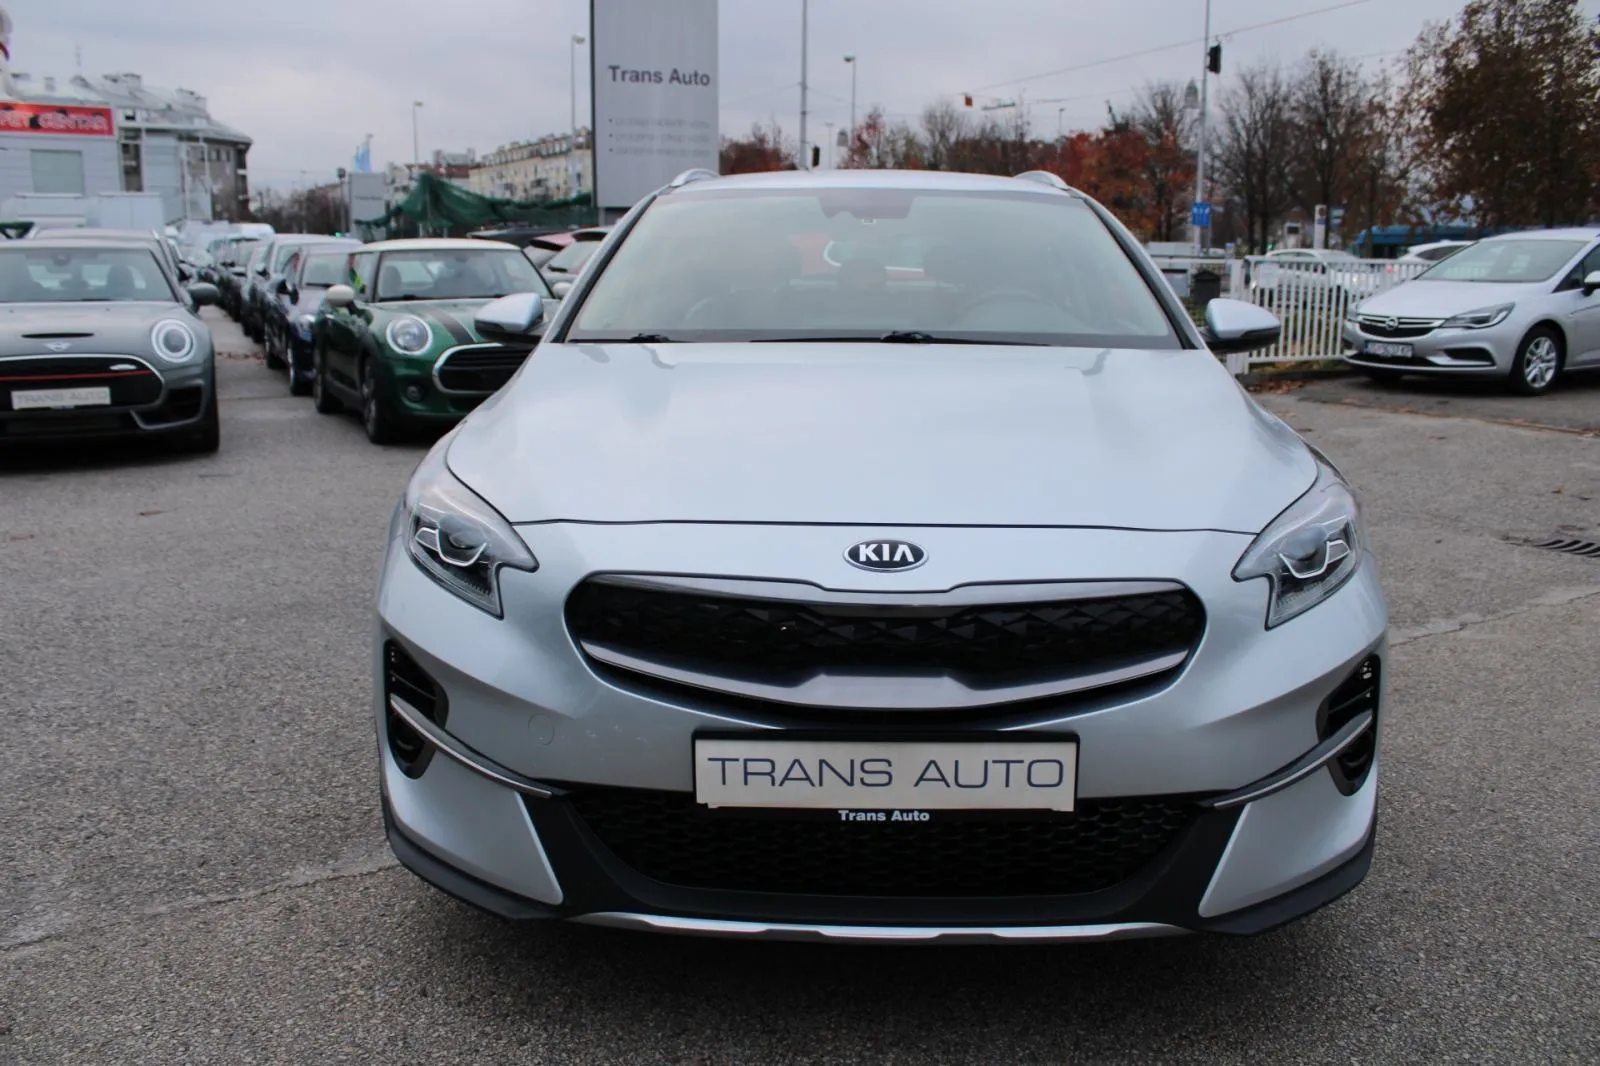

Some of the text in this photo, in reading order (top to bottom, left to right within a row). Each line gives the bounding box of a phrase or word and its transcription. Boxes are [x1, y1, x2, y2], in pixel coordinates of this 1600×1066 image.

[608, 64, 710, 86] Trans Auto
[859, 543, 915, 562] KIA
[707, 757, 1064, 789] TRANS AUTO
[838, 809, 930, 821] Trans Auto
